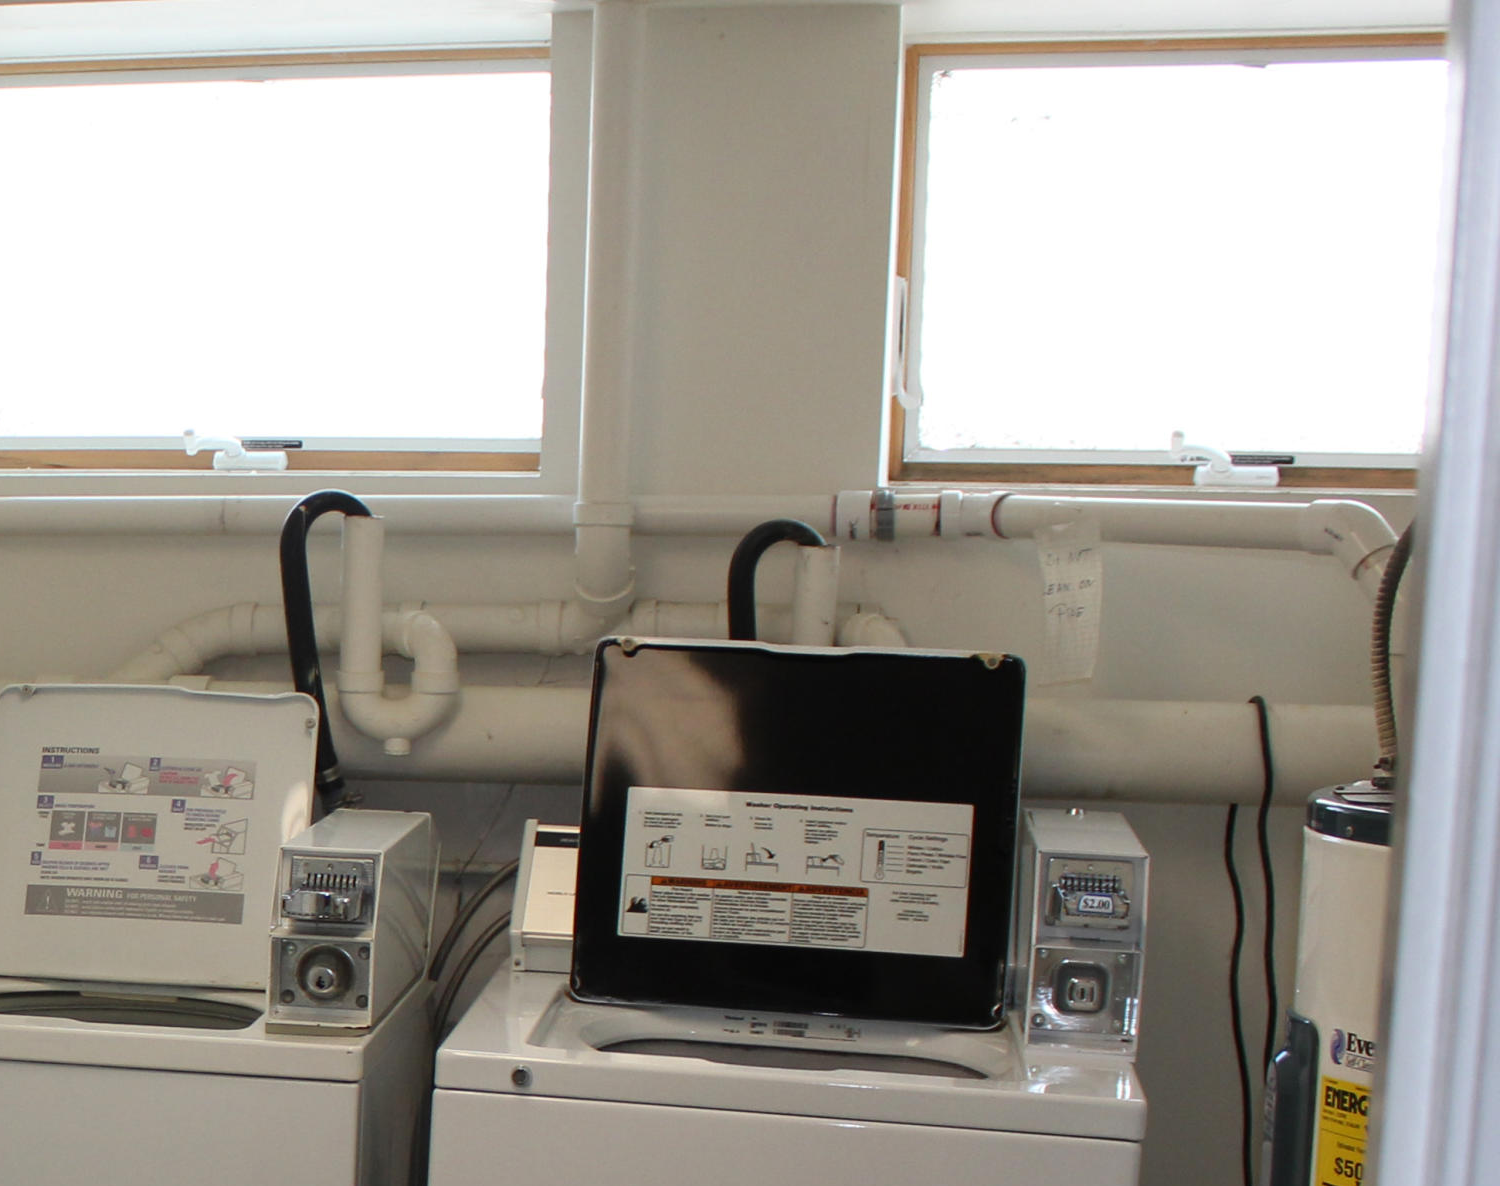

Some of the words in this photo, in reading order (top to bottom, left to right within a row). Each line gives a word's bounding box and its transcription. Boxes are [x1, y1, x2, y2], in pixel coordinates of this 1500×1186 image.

[42, 746, 100, 754] INSTRUCTIONS
[773, 802, 808, 811] Operating
[810, 804, 854, 813] Instructions
[66, 887, 123, 899] WARNING
[1082, 897, 1111, 911] $2.00
